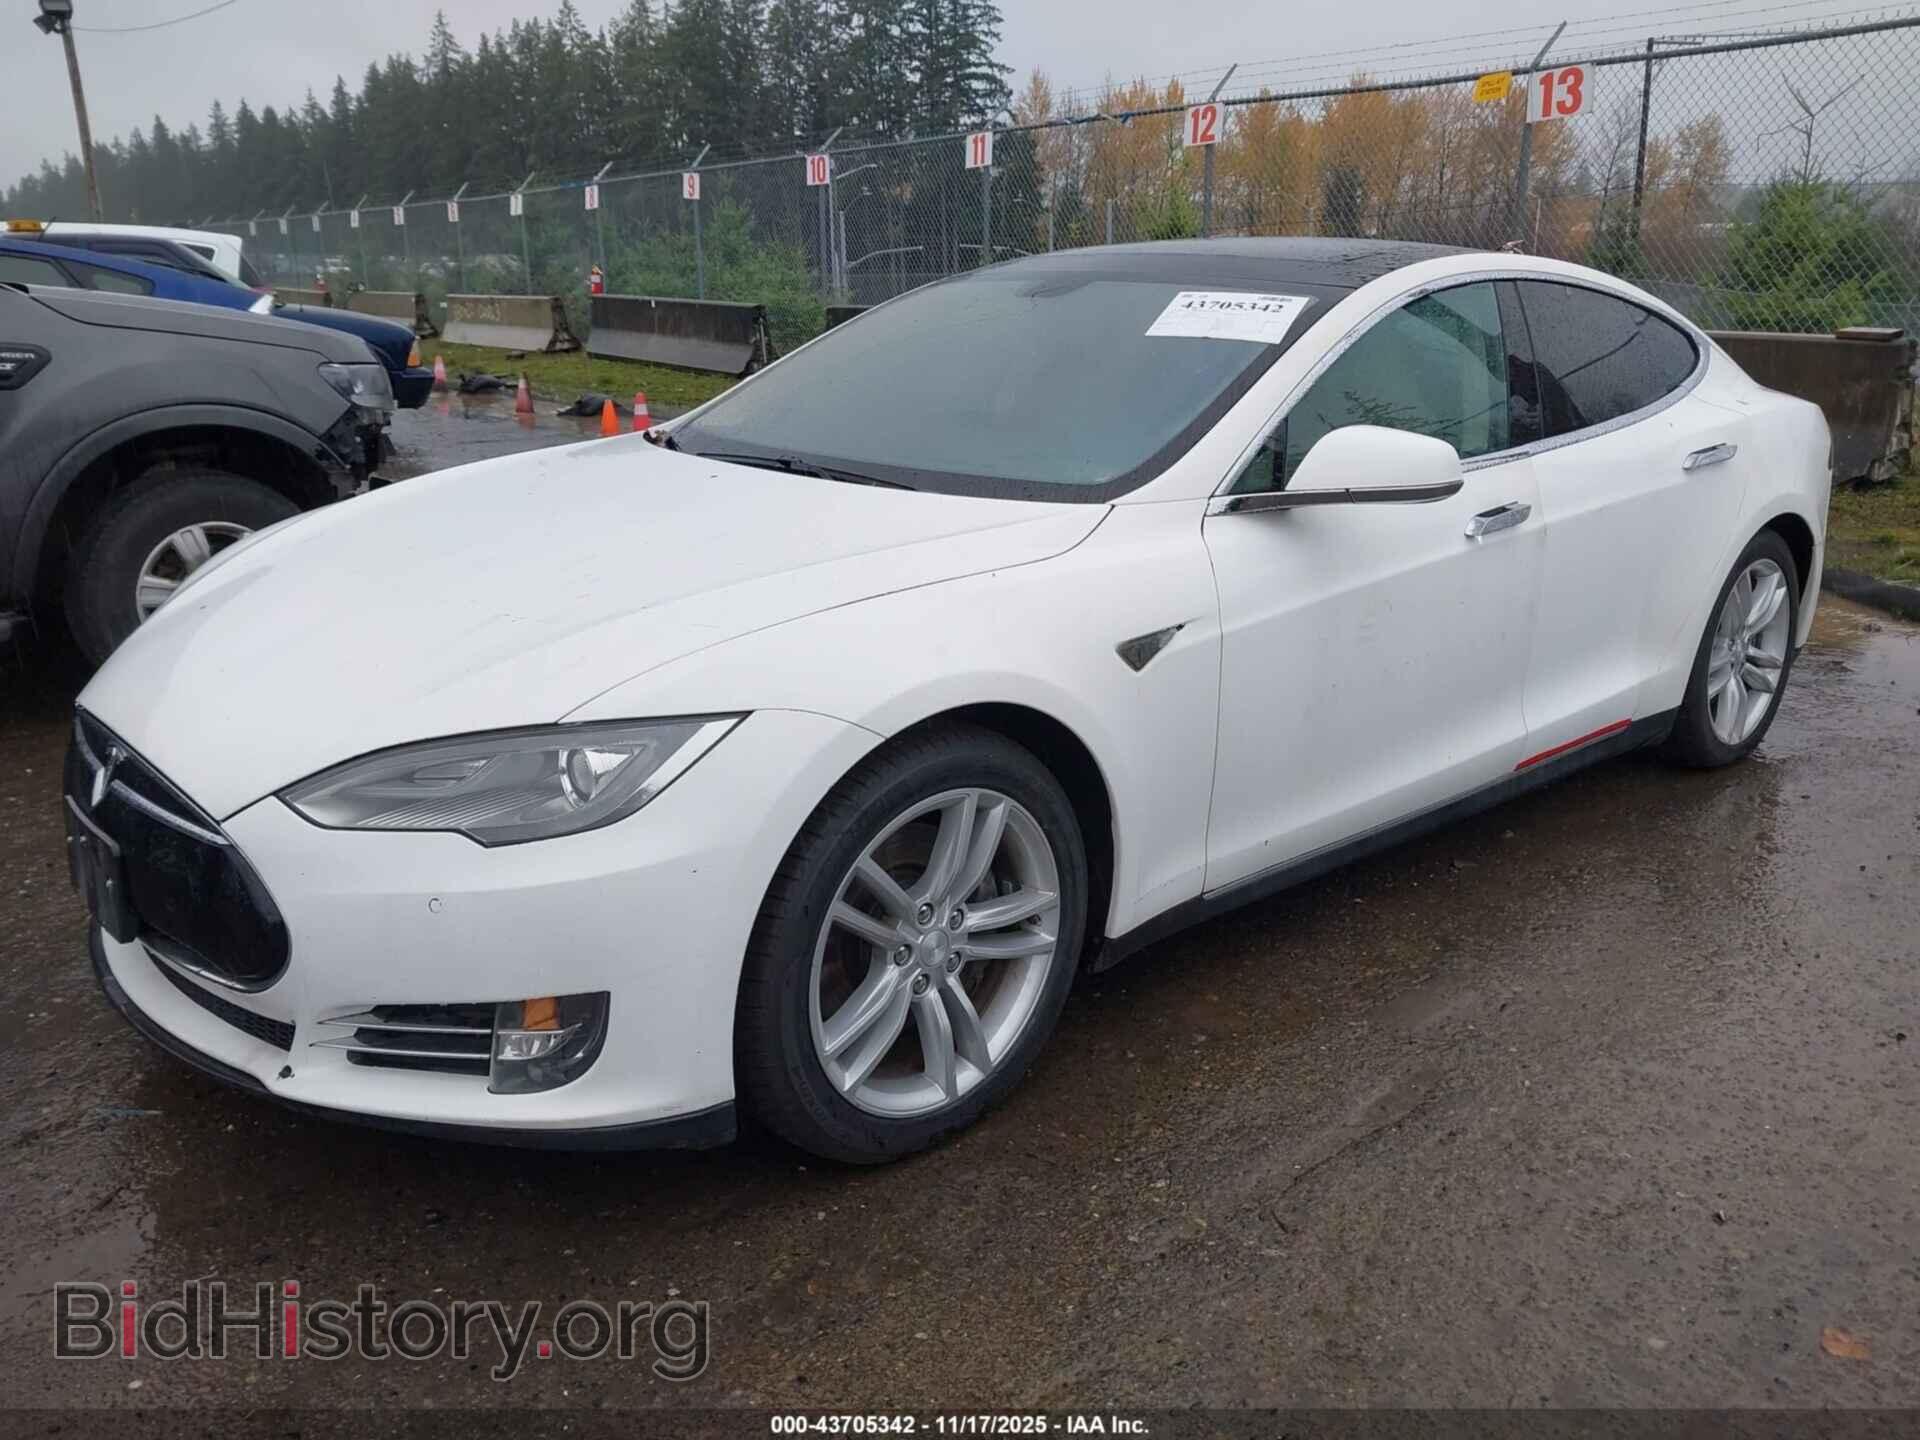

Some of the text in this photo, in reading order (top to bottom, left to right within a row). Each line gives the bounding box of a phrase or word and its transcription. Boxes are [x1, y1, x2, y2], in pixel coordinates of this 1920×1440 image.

[1540, 67, 1585, 117] 13
[1190, 105, 1217, 144] 12
[972, 134, 986, 165] 11
[811, 156, 826, 183] 10
[687, 175, 696, 197] 9
